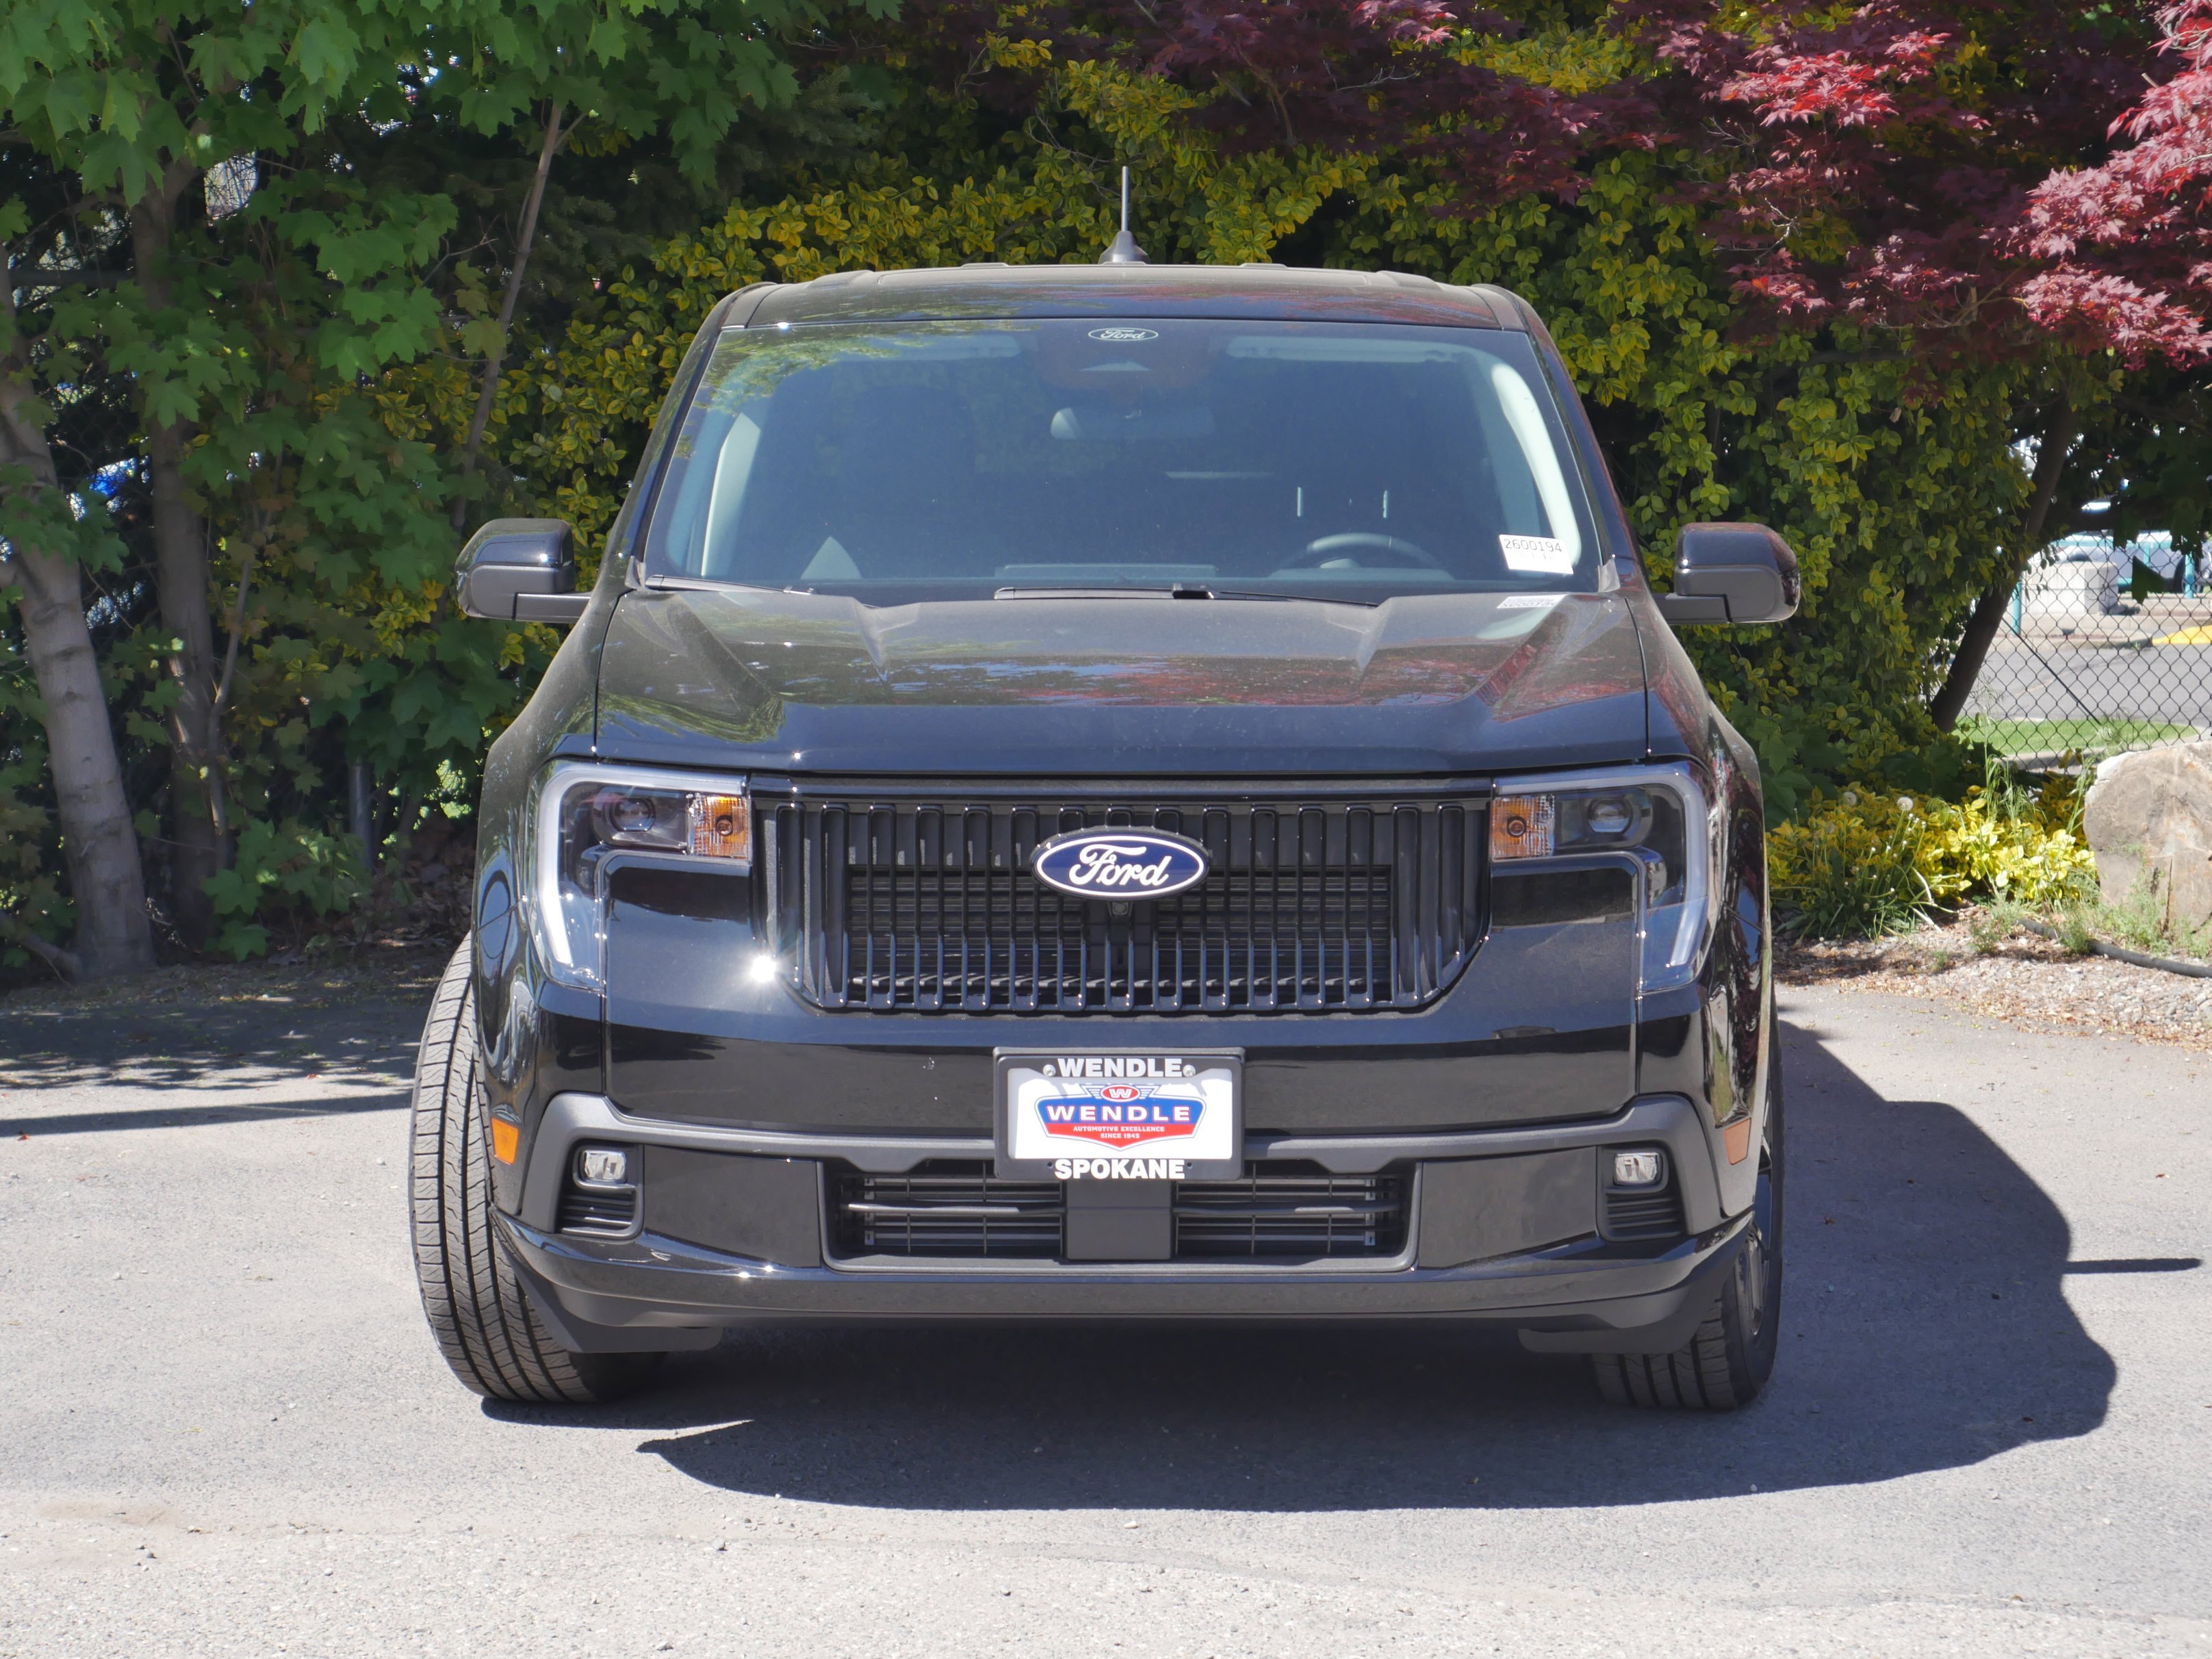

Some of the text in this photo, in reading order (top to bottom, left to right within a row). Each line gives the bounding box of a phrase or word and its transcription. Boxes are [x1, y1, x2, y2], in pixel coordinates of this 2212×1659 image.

[1101, 329, 1146, 339] Ford
[1503, 539, 1562, 552] 2600194
[1069, 843, 1172, 886] Ford
[1057, 1057, 1183, 1077] WENDLE
[1046, 1105, 1190, 1122] WENDLE
[1055, 1159, 1185, 1179] SPOKANE
